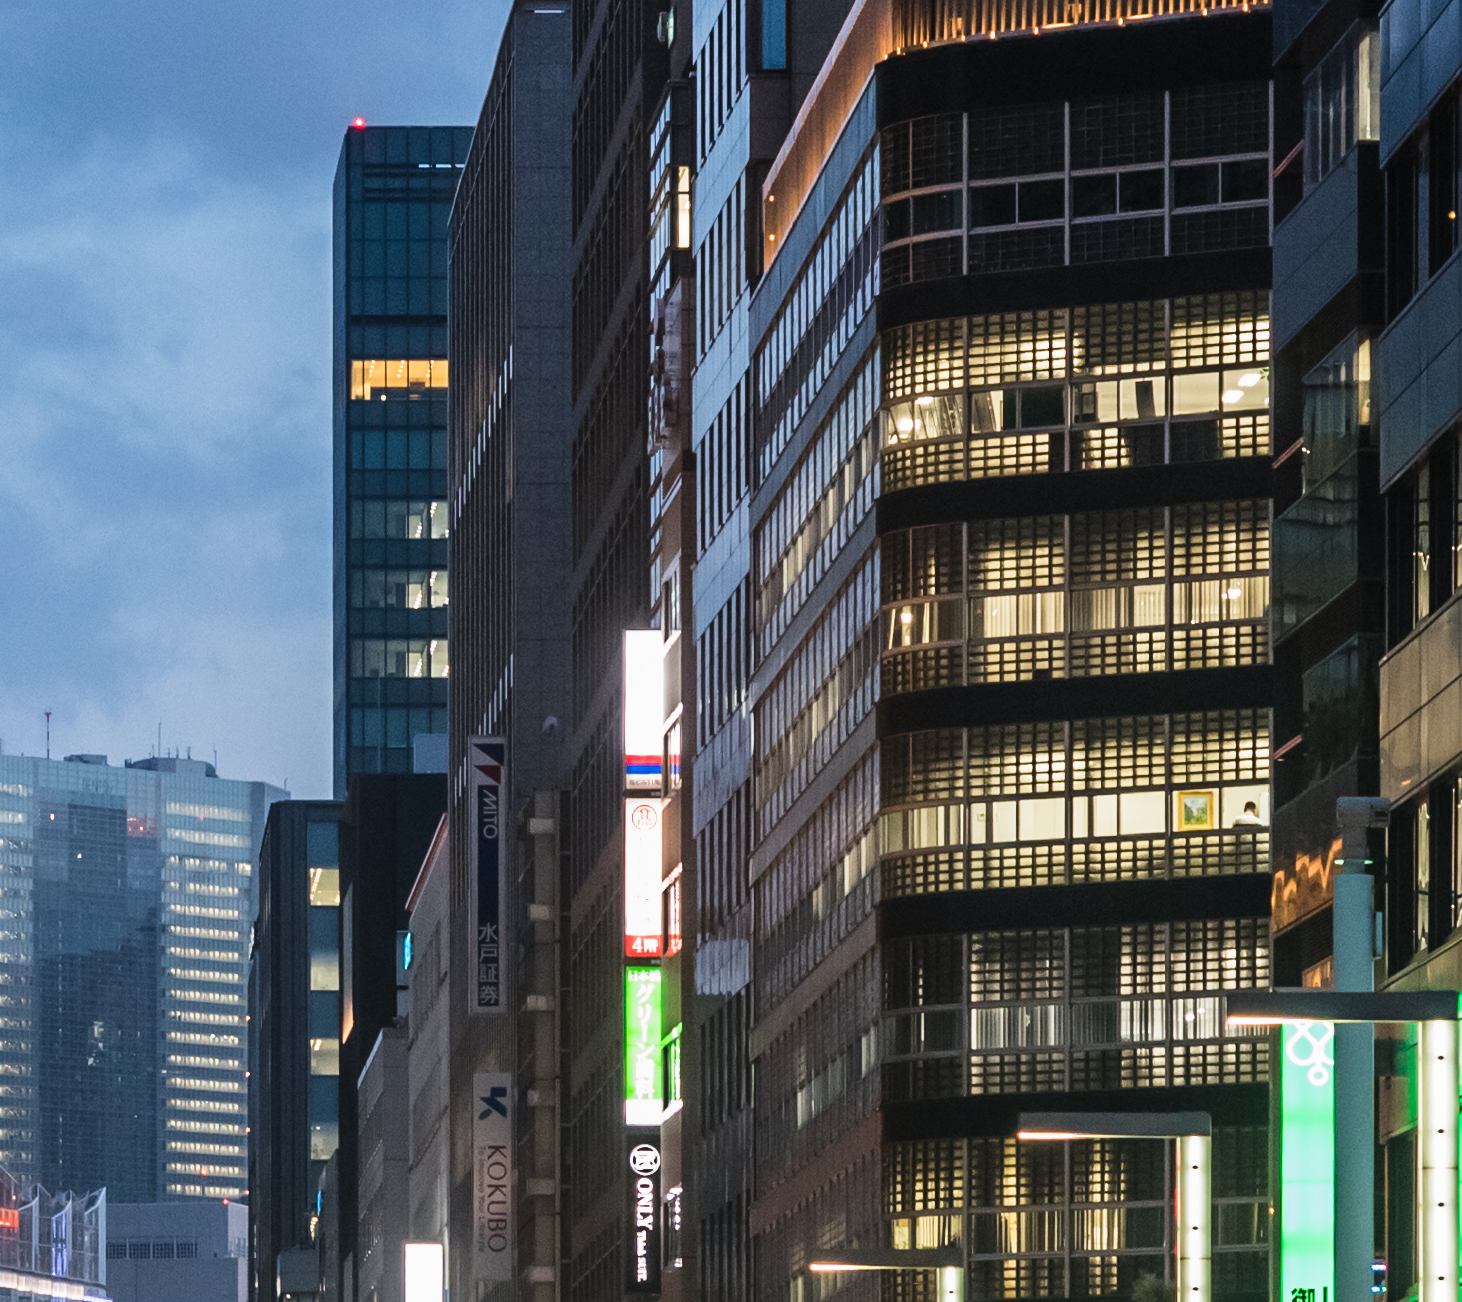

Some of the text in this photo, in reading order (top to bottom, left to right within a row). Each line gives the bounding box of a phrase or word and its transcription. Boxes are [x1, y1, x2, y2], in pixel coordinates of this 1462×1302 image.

[483, 789, 498, 840] MITO
[479, 922, 498, 1004] 水戸証券
[487, 1145, 507, 1252] KOKUBO
[637, 1178, 653, 1230] ONLY
